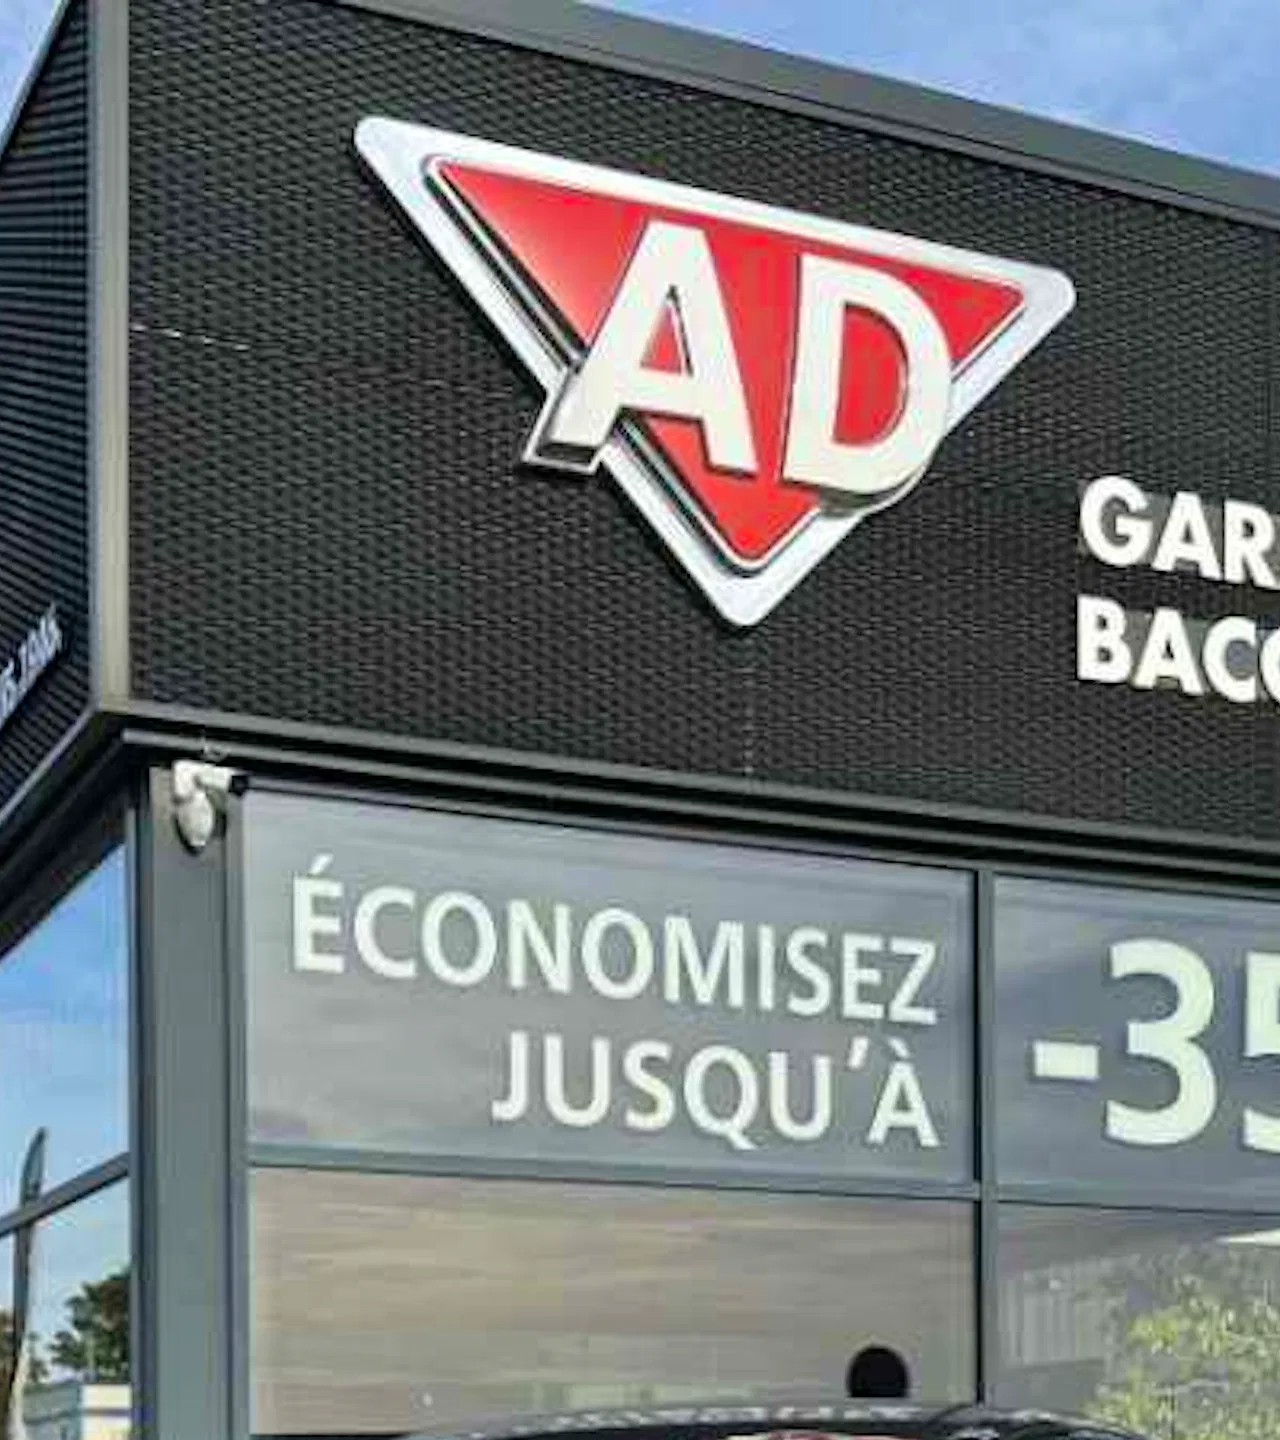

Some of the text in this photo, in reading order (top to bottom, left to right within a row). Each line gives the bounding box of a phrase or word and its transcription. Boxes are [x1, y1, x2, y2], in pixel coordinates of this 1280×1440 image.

[526, 217, 952, 505] AD
[292, 855, 938, 1025] ÉCONOMISEZ
[492, 1032, 939, 1150] JUSQU'À
